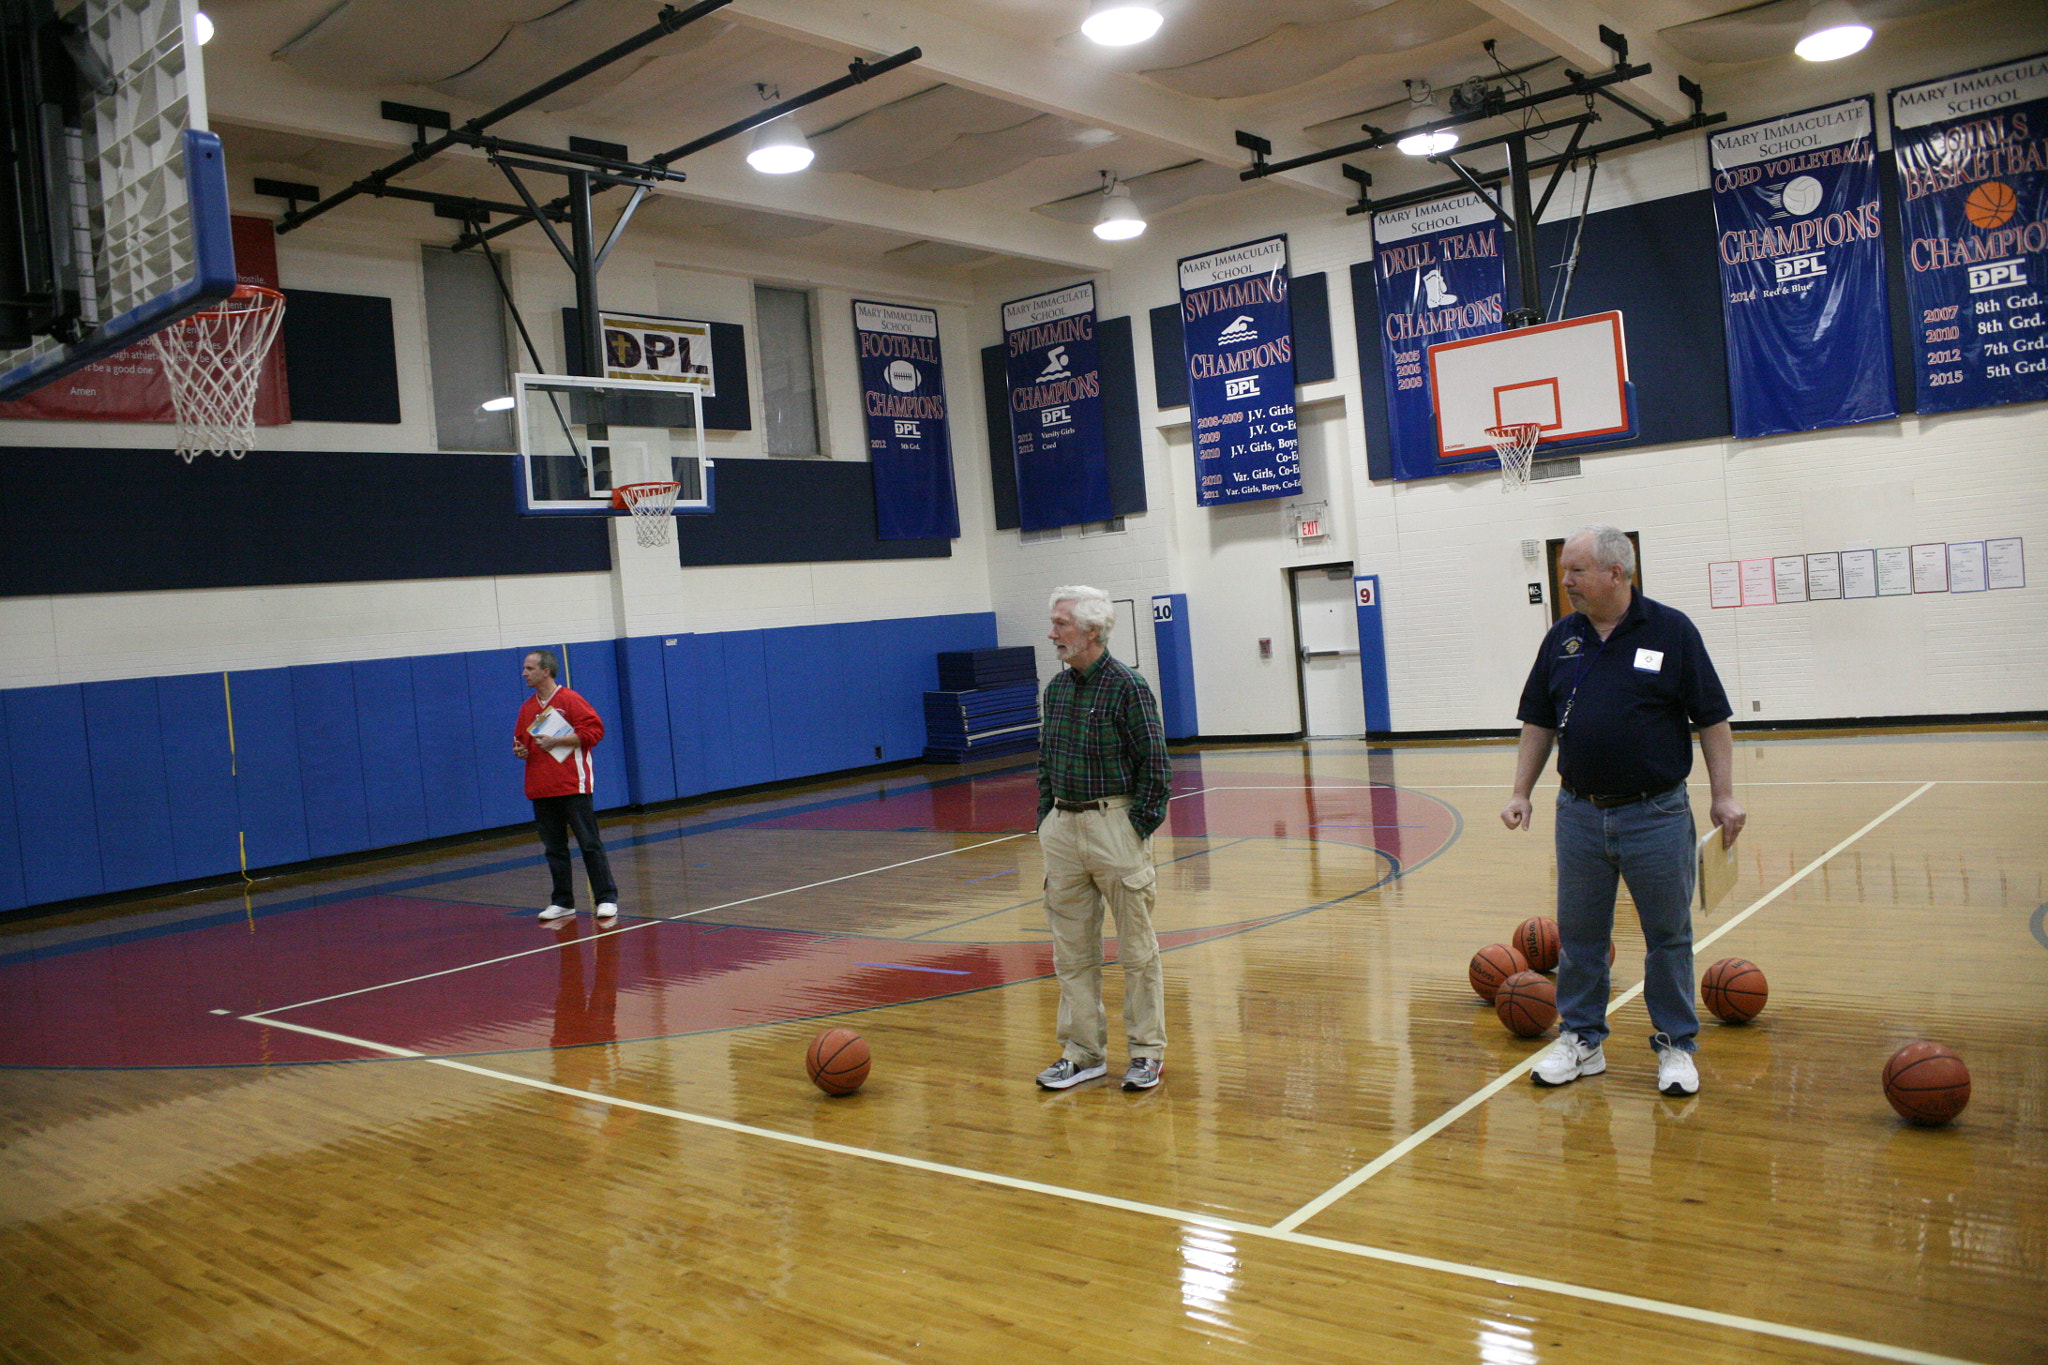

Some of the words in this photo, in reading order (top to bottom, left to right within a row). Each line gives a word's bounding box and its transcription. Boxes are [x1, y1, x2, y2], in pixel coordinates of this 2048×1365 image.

[1900, 86, 1948, 108] MARY
[1947, 89, 2022, 116] SCHOOL
[1717, 131, 1759, 151] MARY
[1764, 106, 1864, 141] IMMACULATE
[1759, 134, 1822, 158] SCHOOL
[1715, 166, 1762, 194] COED
[1378, 209, 1412, 227] MARY
[1411, 215, 1462, 234] SCHOOL
[1721, 201, 1881, 265] CHAMPIONS
[1183, 259, 1216, 275] MARY
[1215, 242, 1282, 265] IMMACULATE
[1380, 241, 1436, 280] DRILL
[1439, 228, 1499, 262] TEAM
[1211, 264, 1255, 282] SCHOOL
[1775, 256, 1828, 279] DPL
[1969, 263, 2027, 289] DPL
[1185, 273, 1285, 323] SWIMMING
[1763, 284, 1780, 298] Red
[1781, 286, 1790, 296] &
[1791, 281, 1813, 294] Blue
[1007, 303, 1031, 318] MARY
[1033, 288, 1090, 311] IMMACULATE
[1923, 305, 1959, 324] 2007
[1975, 299, 2001, 315] 8th
[2006, 292, 2044, 309] Grd.
[858, 306, 881, 318] MARY
[883, 308, 933, 324] IMMACULATE
[881, 319, 913, 333] SCHOOL
[1030, 307, 1067, 323] SCHOOL
[1386, 292, 1503, 341] CHAMPIONS
[1009, 314, 1093, 359] SWIMMING
[1925, 326, 1960, 343] 2010
[1977, 319, 2004, 335] 8th
[2009, 312, 2046, 330] Grd.
[604, 328, 708, 375] DPL
[859, 332, 938, 364] FOOTBALL
[1190, 335, 1291, 380] CHAMPIONS
[1927, 348, 1962, 365] 2012
[1984, 341, 2009, 357] 7th
[2012, 336, 2048, 353] Grd.
[113, 364, 136, 376] good
[1929, 370, 1964, 387] 2015
[1986, 363, 2011, 379] 5th
[70, 387, 96, 396] Amen
[1012, 370, 1100, 412] CHAMPIONS
[1226, 379, 1260, 397] DPL
[866, 390, 944, 420] CHAMPIONS
[1041, 408, 1072, 425] DPL
[1247, 408, 1266, 423] J.V.
[1268, 404, 1294, 417] Girls
[895, 422, 921, 436] DPL
[1249, 424, 1267, 439] J.V.
[1230, 444, 1247, 458] J.V.
[1250, 440, 1275, 453] Girls,
[1233, 472, 1250, 482] Var.
[1252, 467, 1276, 479] Girls,
[1226, 488, 1240, 496] Var.
[1241, 485, 1261, 494] Girls,
[1301, 520, 1319, 536] EXIT
[1359, 588, 1371, 604] 9
[1154, 605, 1172, 620] 10
